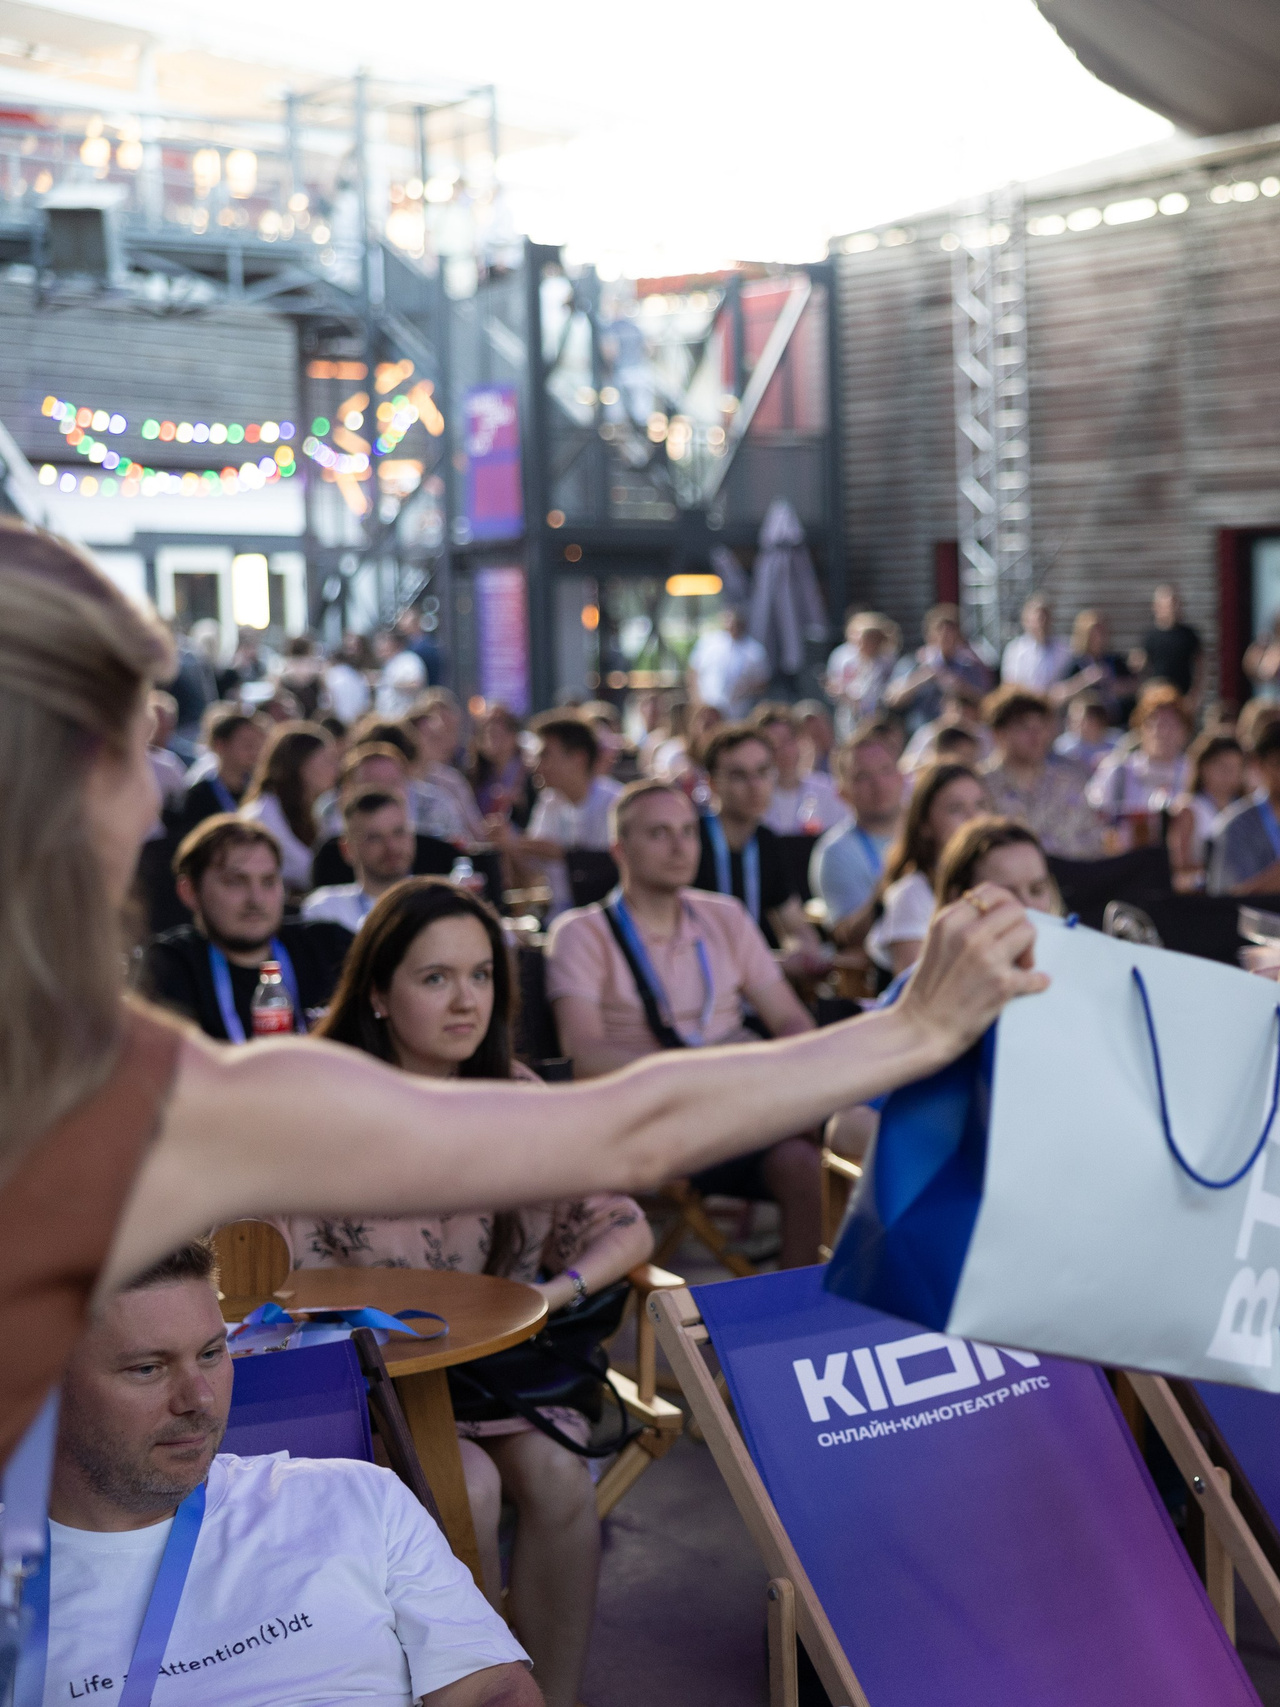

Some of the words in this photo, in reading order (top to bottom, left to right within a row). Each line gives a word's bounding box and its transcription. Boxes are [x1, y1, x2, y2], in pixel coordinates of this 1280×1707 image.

[817, 1389, 1011, 1447] ОНЛАЙН-КИНОТЕАТР
[1011, 1375, 1051, 1398] МТС
[69, 1675, 114, 1699] Life
